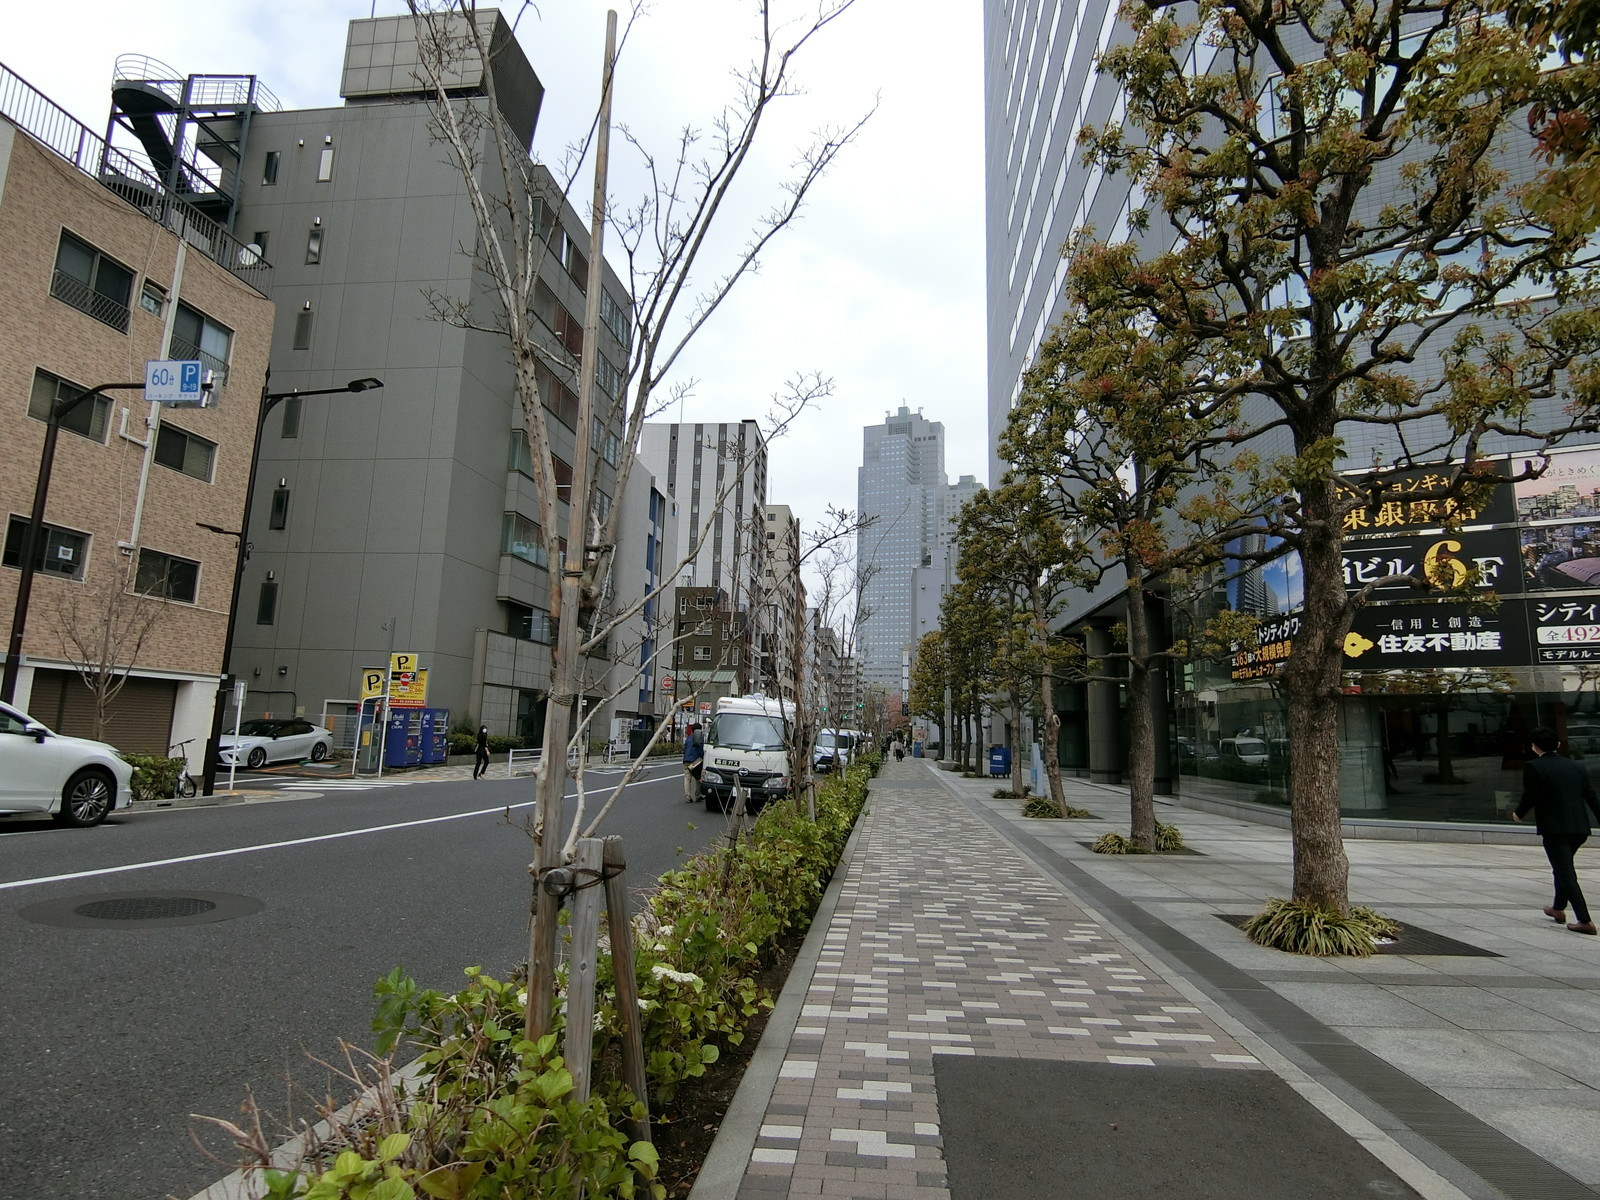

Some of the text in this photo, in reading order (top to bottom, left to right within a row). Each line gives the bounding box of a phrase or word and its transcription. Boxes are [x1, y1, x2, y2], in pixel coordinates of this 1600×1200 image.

[152, 368, 175, 386] 60分
[185, 365, 196, 382] P
[1535, 602, 1597, 622] シティ
[1390, 615, 1483, 631] 信用と創造
[1377, 630, 1502, 654] 住友不動産
[397, 655, 409, 670] P
[367, 674, 380, 691] P
[715, 759, 739, 767] 高圧ガス
